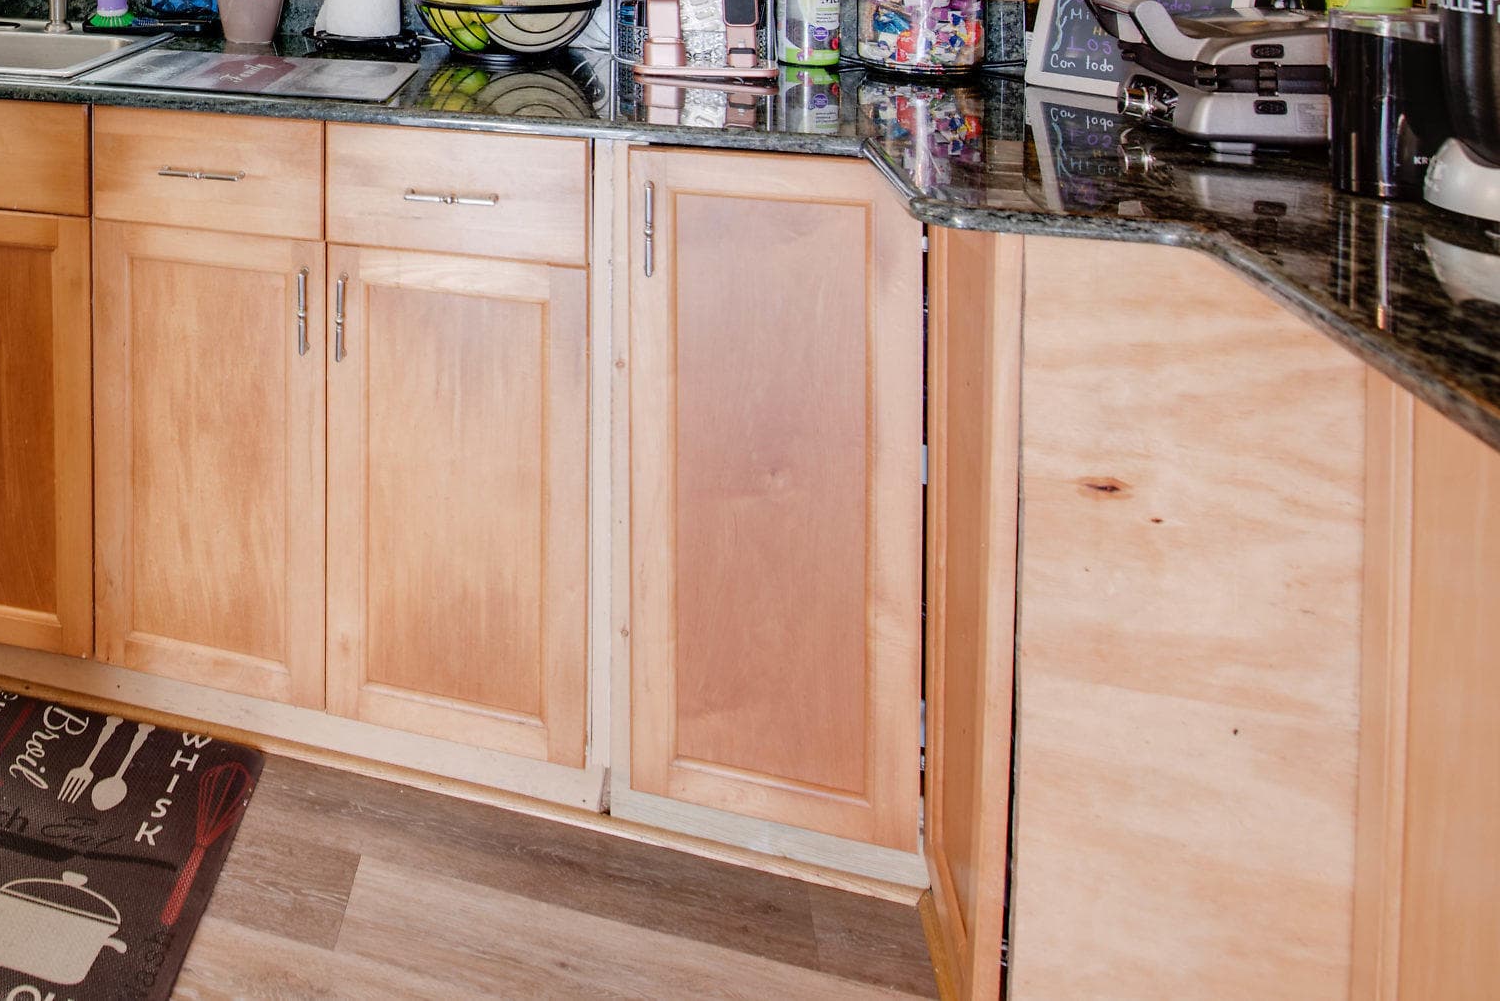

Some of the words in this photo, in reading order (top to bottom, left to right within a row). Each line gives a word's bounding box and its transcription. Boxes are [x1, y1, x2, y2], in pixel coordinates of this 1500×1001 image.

[1050, 53, 1076, 69] Con
[1086, 55, 1114, 73] todo
[9, 705, 90, 790] Broil
